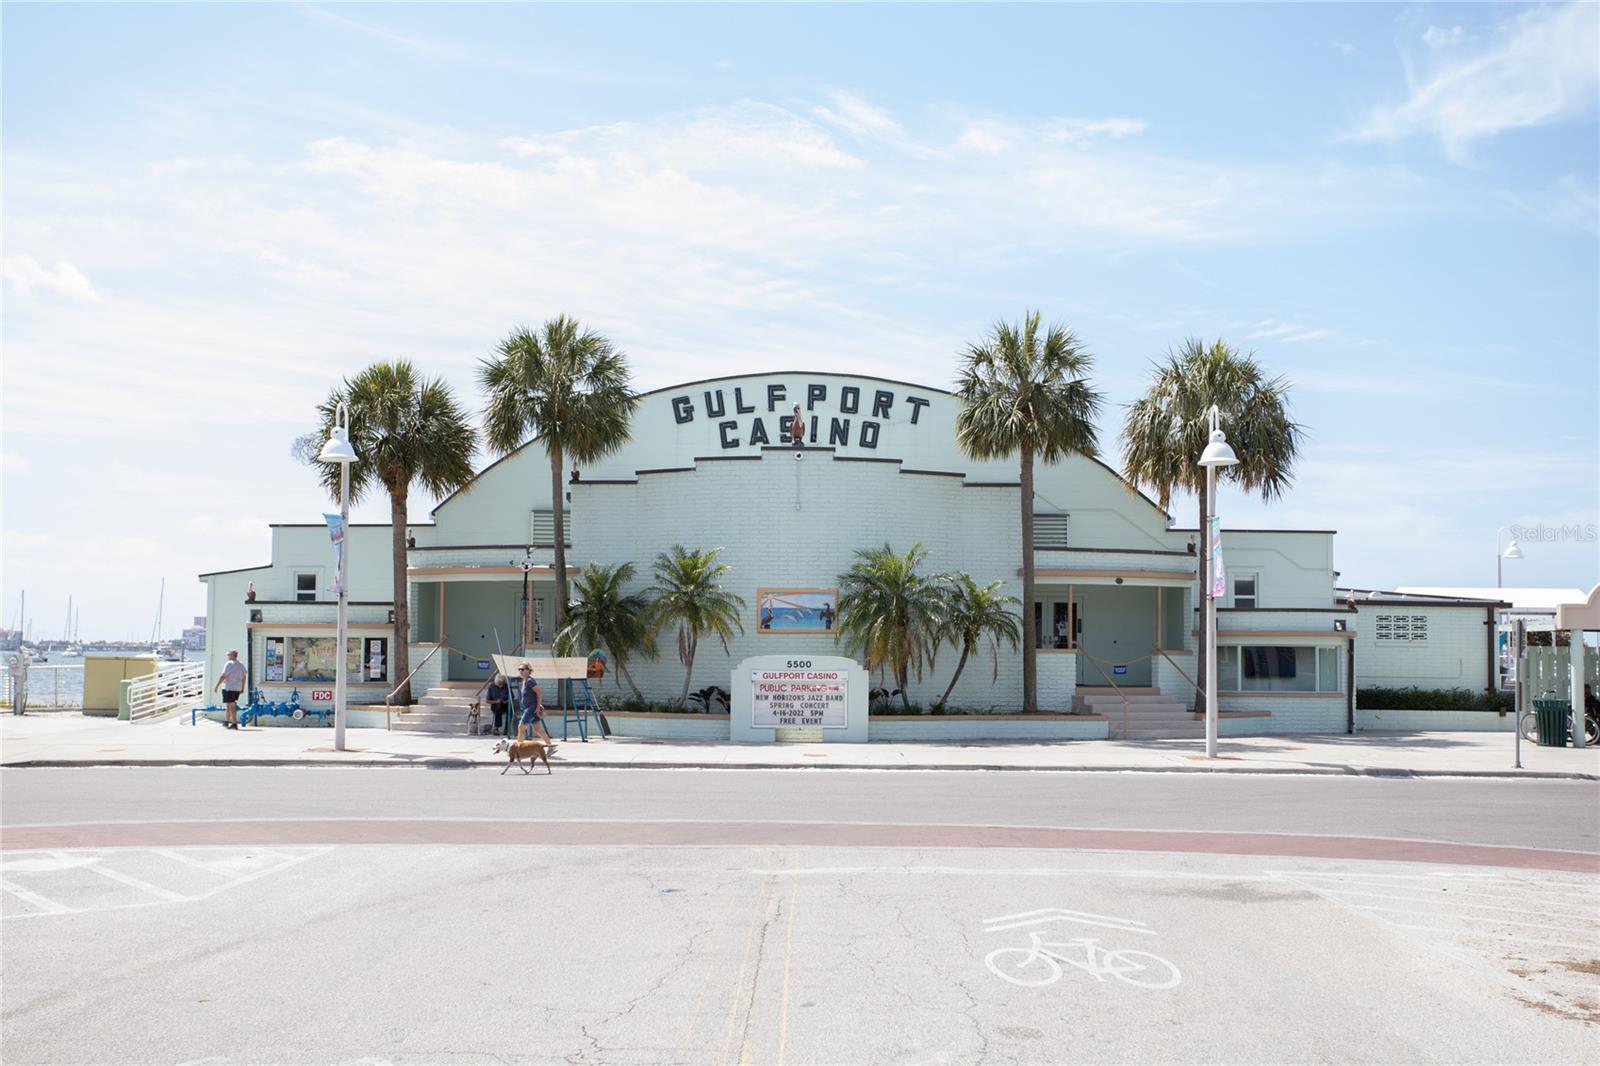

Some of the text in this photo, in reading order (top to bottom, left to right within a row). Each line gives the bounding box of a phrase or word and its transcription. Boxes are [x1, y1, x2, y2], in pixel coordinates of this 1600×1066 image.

[671, 384, 931, 425] GULFPORT
[719, 415, 881, 449] CASINO
[787, 660, 812, 668] 5500
[762, 672, 838, 680] GULFPORT CASINO
[760, 684, 787, 692] PUBLIC
[313, 691, 331, 700] FDC
